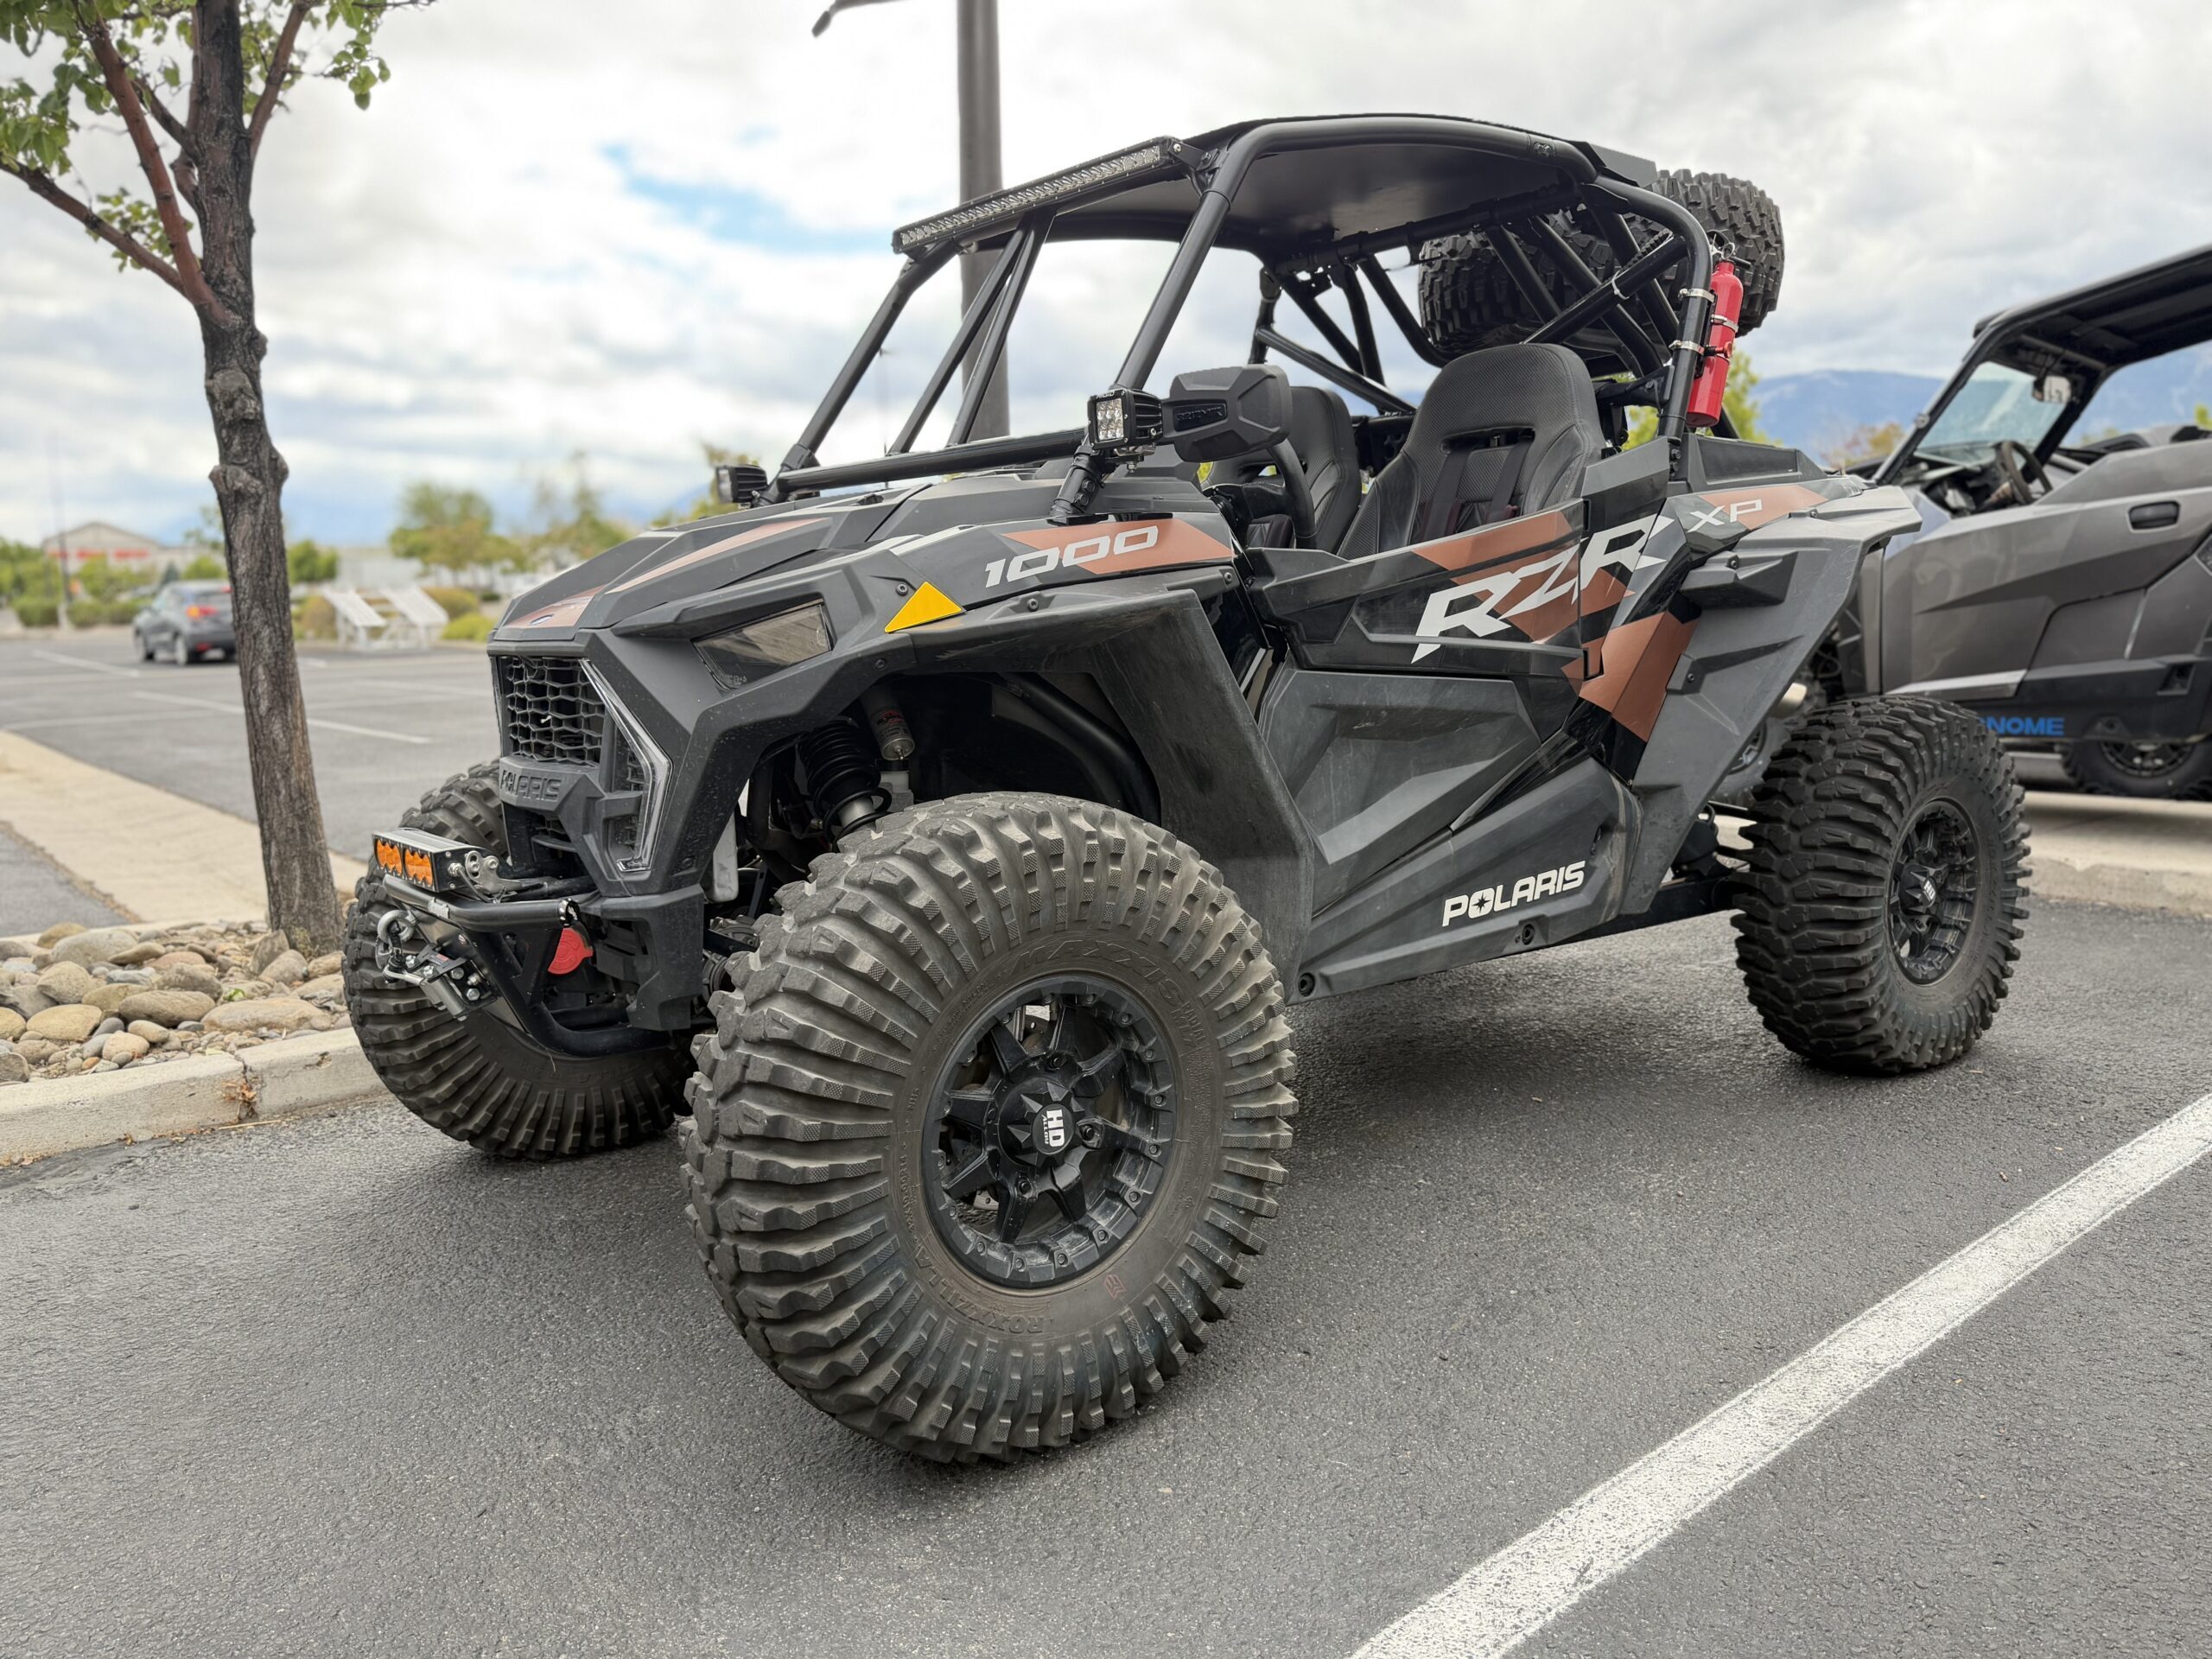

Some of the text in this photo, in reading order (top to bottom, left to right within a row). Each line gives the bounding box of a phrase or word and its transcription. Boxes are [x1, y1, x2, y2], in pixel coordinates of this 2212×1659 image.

[1687, 499, 1763, 532] XP
[985, 525, 1158, 588] 1000
[1411, 515, 1675, 664] RZR
[1977, 716, 2065, 736] NOME
[1442, 861, 1586, 927] POLARIS
[1009, 938, 1183, 1005] MAXXIS
[1046, 1109, 1065, 1147] HD
[914, 1243, 1045, 1334] ROXXZILLA
